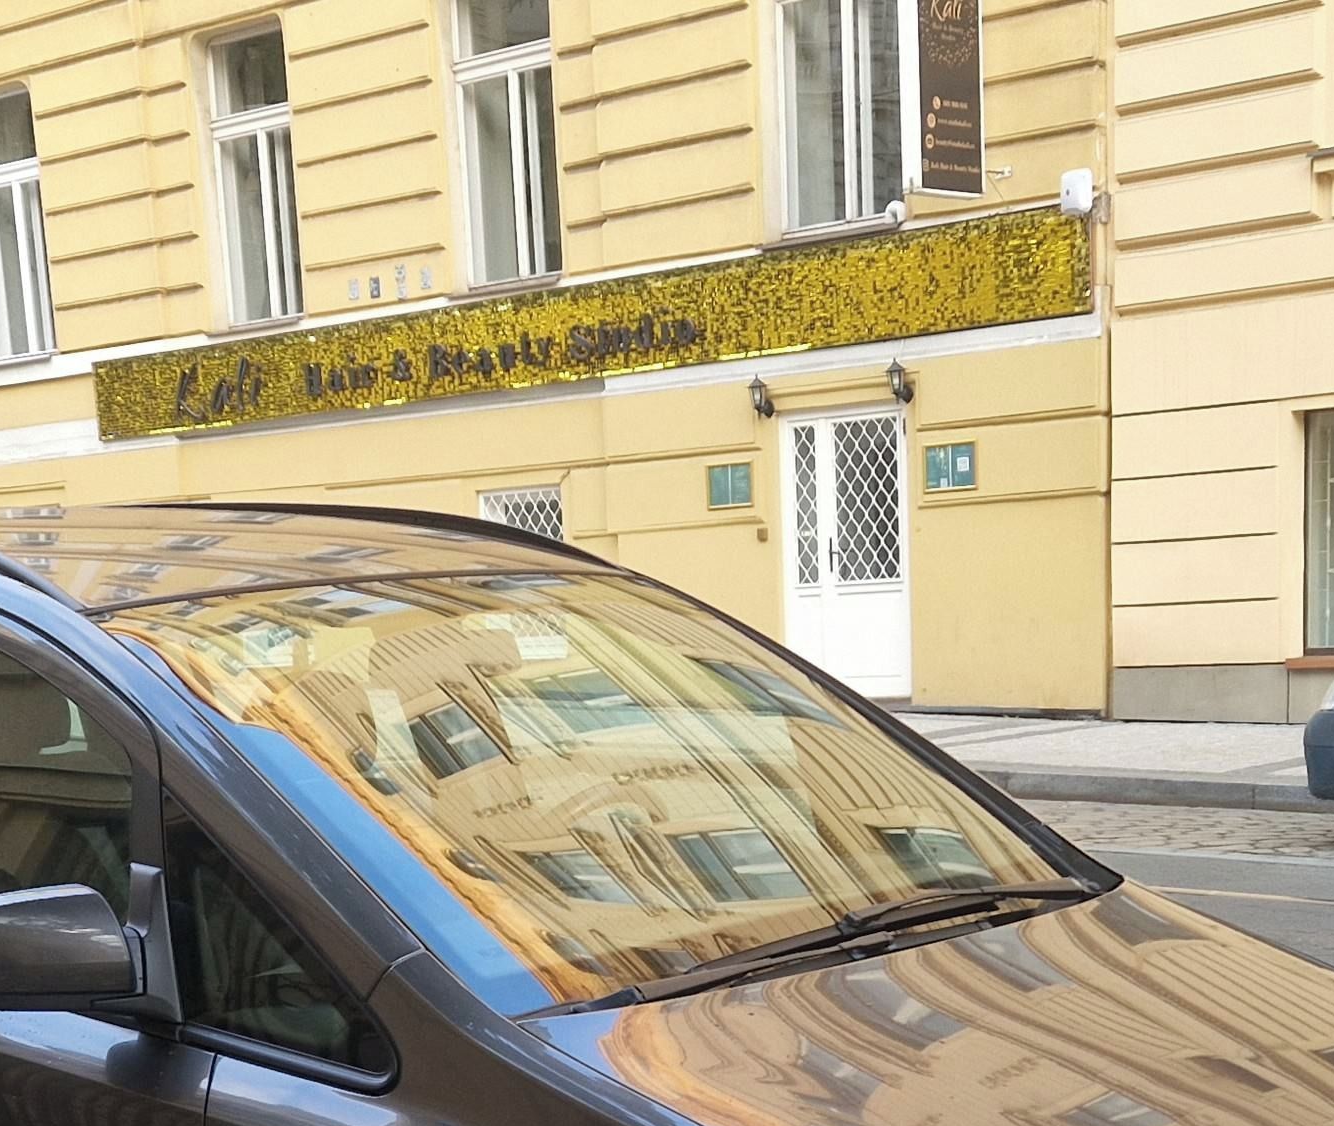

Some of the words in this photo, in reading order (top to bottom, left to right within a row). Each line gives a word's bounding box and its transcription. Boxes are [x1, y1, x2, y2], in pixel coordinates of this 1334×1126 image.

[176, 356, 263, 421] Kali
[303, 354, 378, 398] Hair
[390, 349, 413, 382] &
[427, 330, 554, 379] Beauty
[568, 307, 699, 361] Studio
